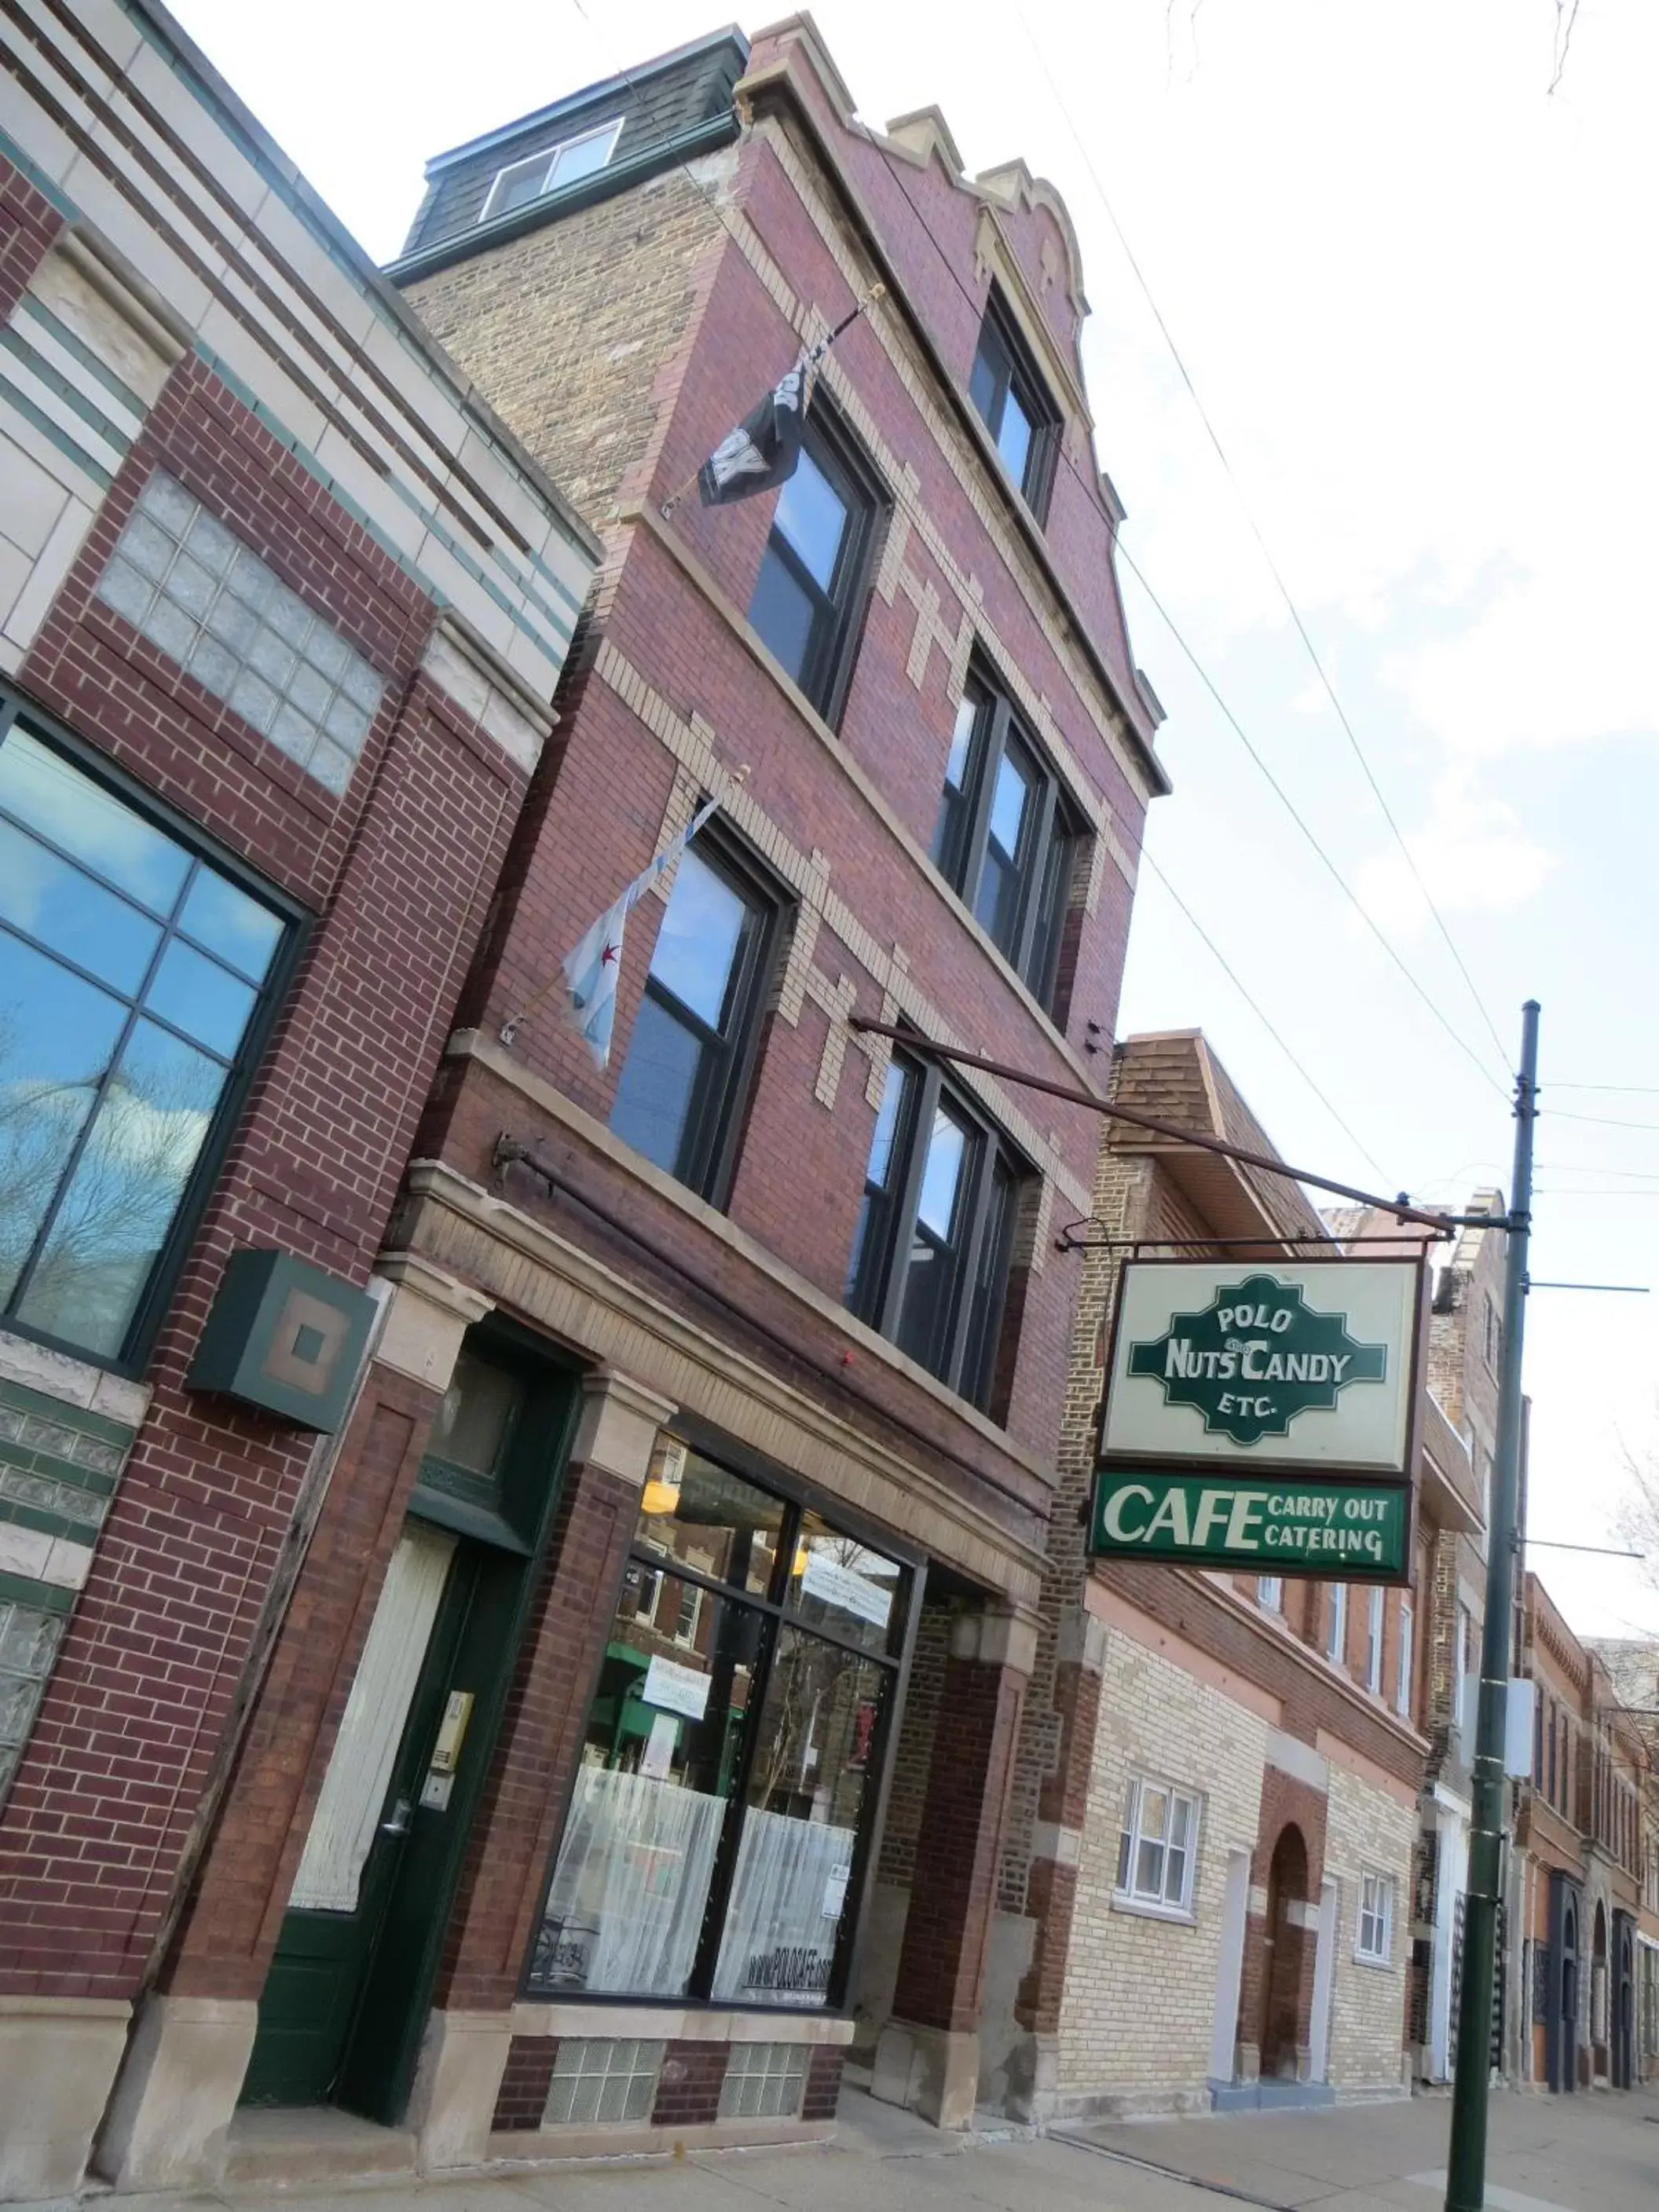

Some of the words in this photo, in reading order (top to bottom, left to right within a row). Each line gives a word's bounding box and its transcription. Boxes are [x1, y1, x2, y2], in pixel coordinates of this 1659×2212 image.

[1218, 1305, 1292, 1332] POLO
[1166, 1339, 1240, 1379] NUTS
[1241, 1339, 1351, 1382] CANDY
[1218, 1393, 1277, 1417] ETC.
[1104, 1485, 1268, 1550] CAFE
[1267, 1496, 1337, 1525] CARRY
[1343, 1497, 1389, 1521] OUT
[1264, 1526, 1381, 1560] CATERING
